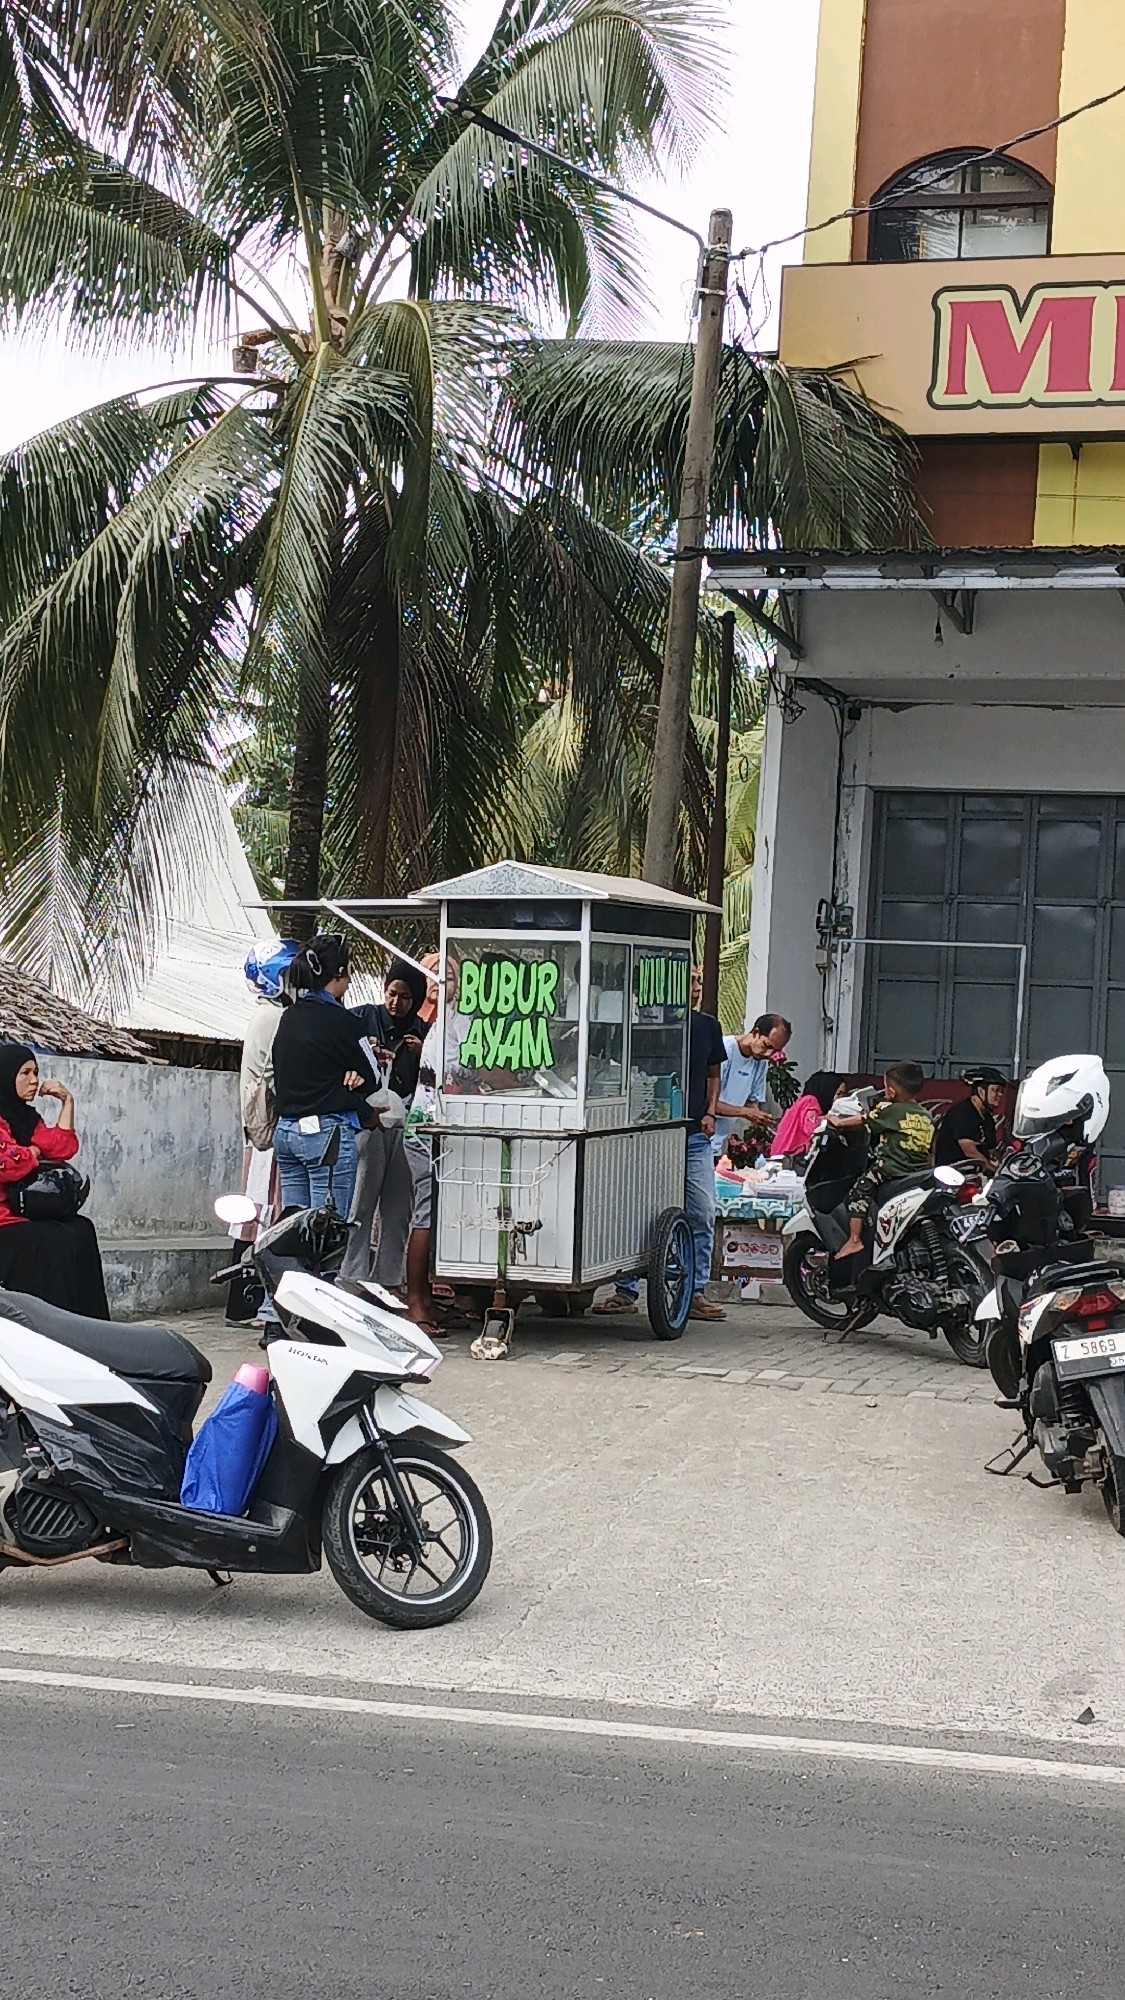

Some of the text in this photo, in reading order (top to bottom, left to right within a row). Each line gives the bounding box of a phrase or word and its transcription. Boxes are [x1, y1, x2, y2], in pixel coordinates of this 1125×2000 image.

[458, 959, 560, 1016] BUBUR
[459, 1015, 555, 1073] AYAM
[1060, 1339, 1116, 1359] Z 5869
